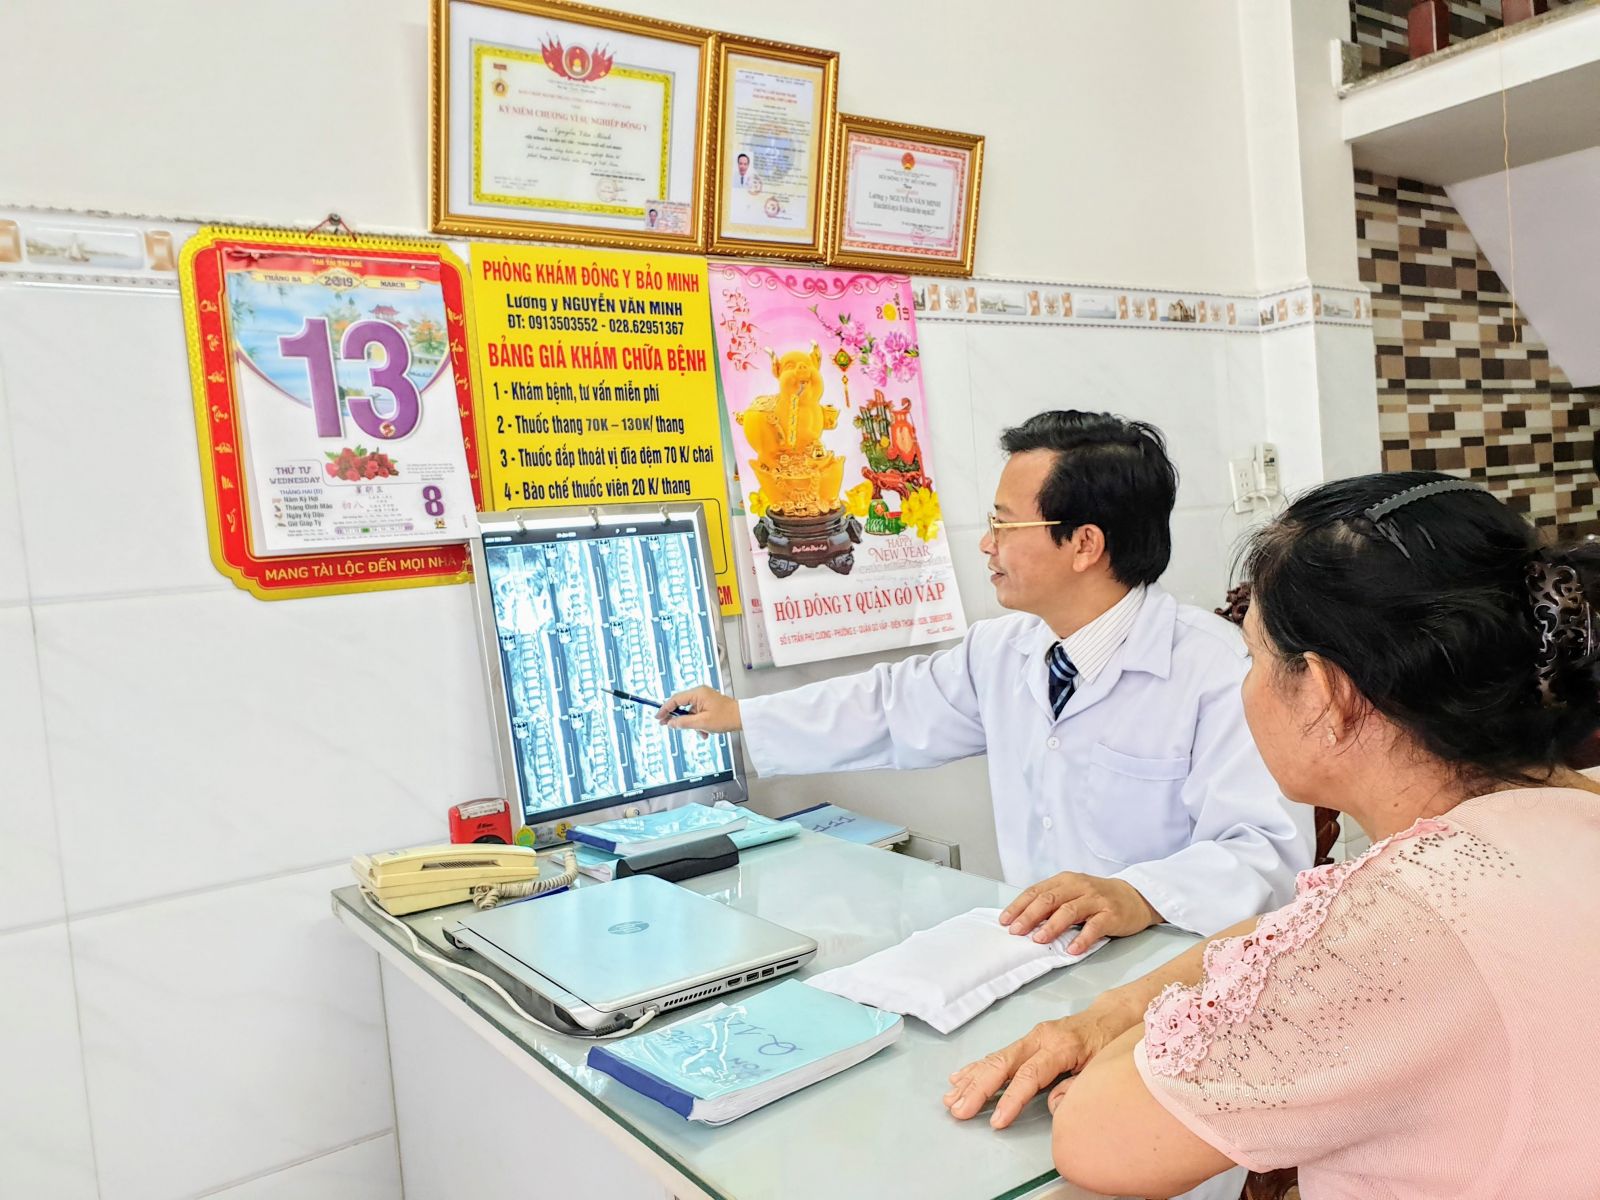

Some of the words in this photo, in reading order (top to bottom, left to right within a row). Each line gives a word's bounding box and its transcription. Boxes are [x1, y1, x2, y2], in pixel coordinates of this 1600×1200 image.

[325, 276, 353, 287] 2019
[483, 256, 531, 283] PHÒNG
[536, 260, 577, 286] KHÁM
[582, 262, 619, 288] ĐÔNG
[623, 269, 632, 288] Y
[636, 262, 662, 291] BẢO
[667, 271, 700, 292] MINH
[507, 293, 547, 311] Lương
[552, 300, 558, 312] y
[562, 293, 616, 314] NGUYỄN
[619, 298, 645, 314] VĂN
[650, 300, 683, 316] MINH
[508, 314, 525, 329] ĐT:
[528, 316, 598, 332] 0913503552
[609, 318, 684, 335] 028.62951367
[488, 335, 534, 368] BẢNG
[539, 340, 567, 369] GIÁ
[571, 340, 618, 370] KHÁM
[622, 344, 663, 371] CHỮA
[667, 344, 707, 376] BỆNH
[279, 318, 421, 440] 13
[494, 382, 499, 400] 1
[512, 381, 542, 401] Khám
[546, 383, 577, 405] bệnh,
[580, 385, 590, 401] tư
[592, 379, 612, 401] vấn
[615, 380, 640, 402] miễn
[643, 383, 660, 404] phí
[497, 416, 504, 434] 2
[515, 412, 549, 434] Thuốc
[552, 416, 583, 435] thang
[586, 418, 608, 432] 70K
[622, 416, 653, 433] 130K/
[655, 416, 685, 435] thang
[500, 449, 508, 467] 3
[518, 445, 552, 468] Thuốc
[555, 443, 575, 468] đắp
[578, 448, 605, 466] thoát
[608, 448, 618, 469] vị
[621, 446, 637, 465] đĩa
[640, 446, 662, 468] đệm
[664, 446, 676, 464] 70
[679, 445, 690, 464] K/
[693, 445, 714, 463] chai
[276, 465, 295, 474] THỨ
[298, 466, 311, 474] TƯ
[504, 483, 512, 500] 4
[523, 480, 545, 500] Bào
[548, 476, 569, 499] chế
[572, 476, 603, 498] thuốc
[605, 479, 628, 497] viên
[632, 478, 645, 495] 20
[648, 478, 659, 495] K/
[661, 478, 691, 498] thang
[423, 485, 444, 516] 8
[868, 547, 898, 561] NEW
[903, 545, 931, 558] YEAR
[887, 536, 912, 548] HAPPY
[265, 564, 309, 581] MANG
[312, 560, 333, 577] TÀI
[337, 560, 365, 578] LỘC
[368, 556, 396, 573] ĐẾN
[400, 557, 424, 574] MỌI
[774, 594, 801, 624] HỘI
[805, 593, 842, 618] ĐÔNG
[845, 596, 853, 613] Y
[856, 591, 891, 616] QUẬN
[894, 586, 913, 605] GÒ
[915, 575, 945, 601] VẤP
